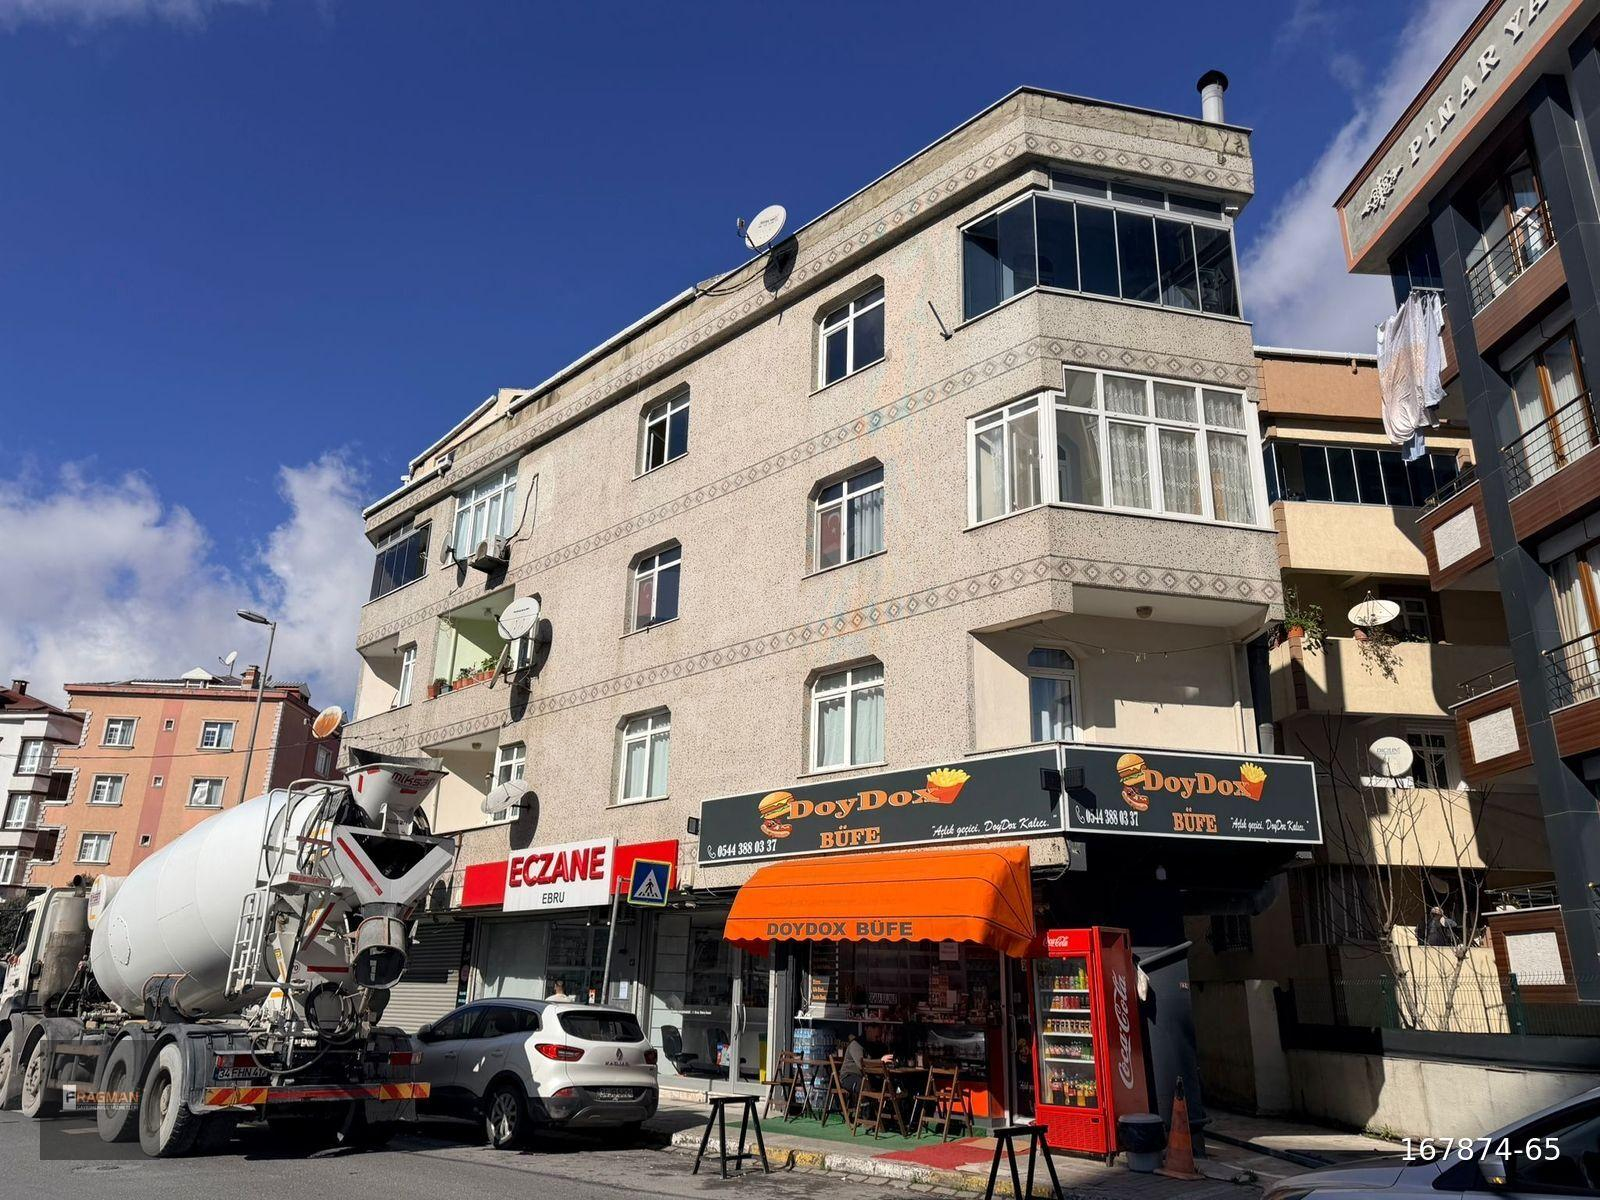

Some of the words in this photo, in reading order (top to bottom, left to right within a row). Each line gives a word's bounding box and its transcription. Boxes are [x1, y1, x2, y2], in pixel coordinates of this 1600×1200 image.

[1407, 44, 1502, 168] PINAR
[1142, 770, 1253, 798] DoyDox
[786, 789, 940, 820] DoyDox
[983, 818, 1017, 833] DoyDox
[1085, 810, 1104, 825] 0544
[1105, 810, 1119, 826] 388
[1120, 811, 1130, 827] 03
[1130, 812, 1139, 828] 37
[1172, 807, 1218, 833] BÜFE
[717, 843, 736, 858] 0544
[738, 840, 752, 856] 388
[754, 840, 765, 855] 03
[767, 838, 778, 853] 37
[819, 825, 881, 849] BÜFE
[509, 846, 606, 887] ECZANE
[541, 892, 565, 904] EBRU
[766, 922, 846, 936] DOYDOX
[856, 920, 912, 936] BÜFE
